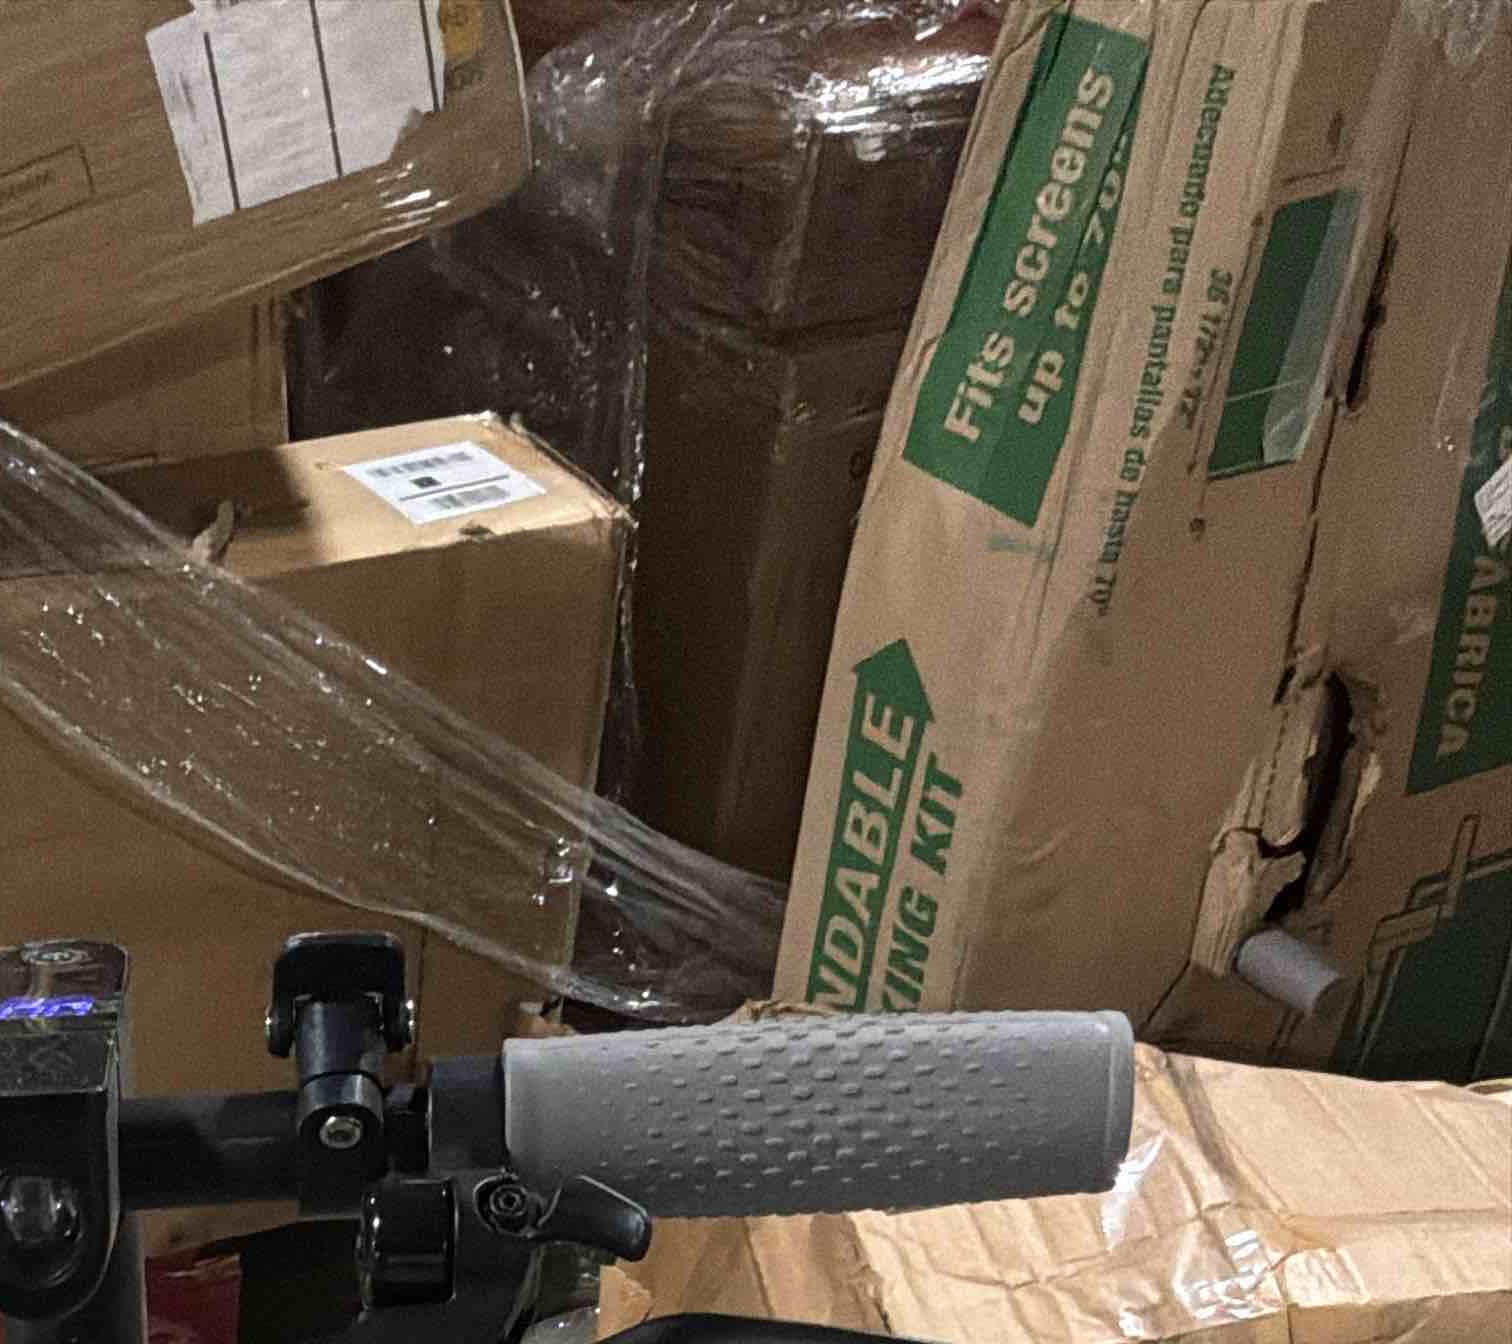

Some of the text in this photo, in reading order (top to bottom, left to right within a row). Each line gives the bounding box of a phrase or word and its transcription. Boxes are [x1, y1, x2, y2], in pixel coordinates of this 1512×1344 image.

[943, 65, 1114, 442] Fits screens
[1017, 349, 1065, 425] up
[1054, 271, 1090, 331] to
[910, 752, 964, 878] KIT
